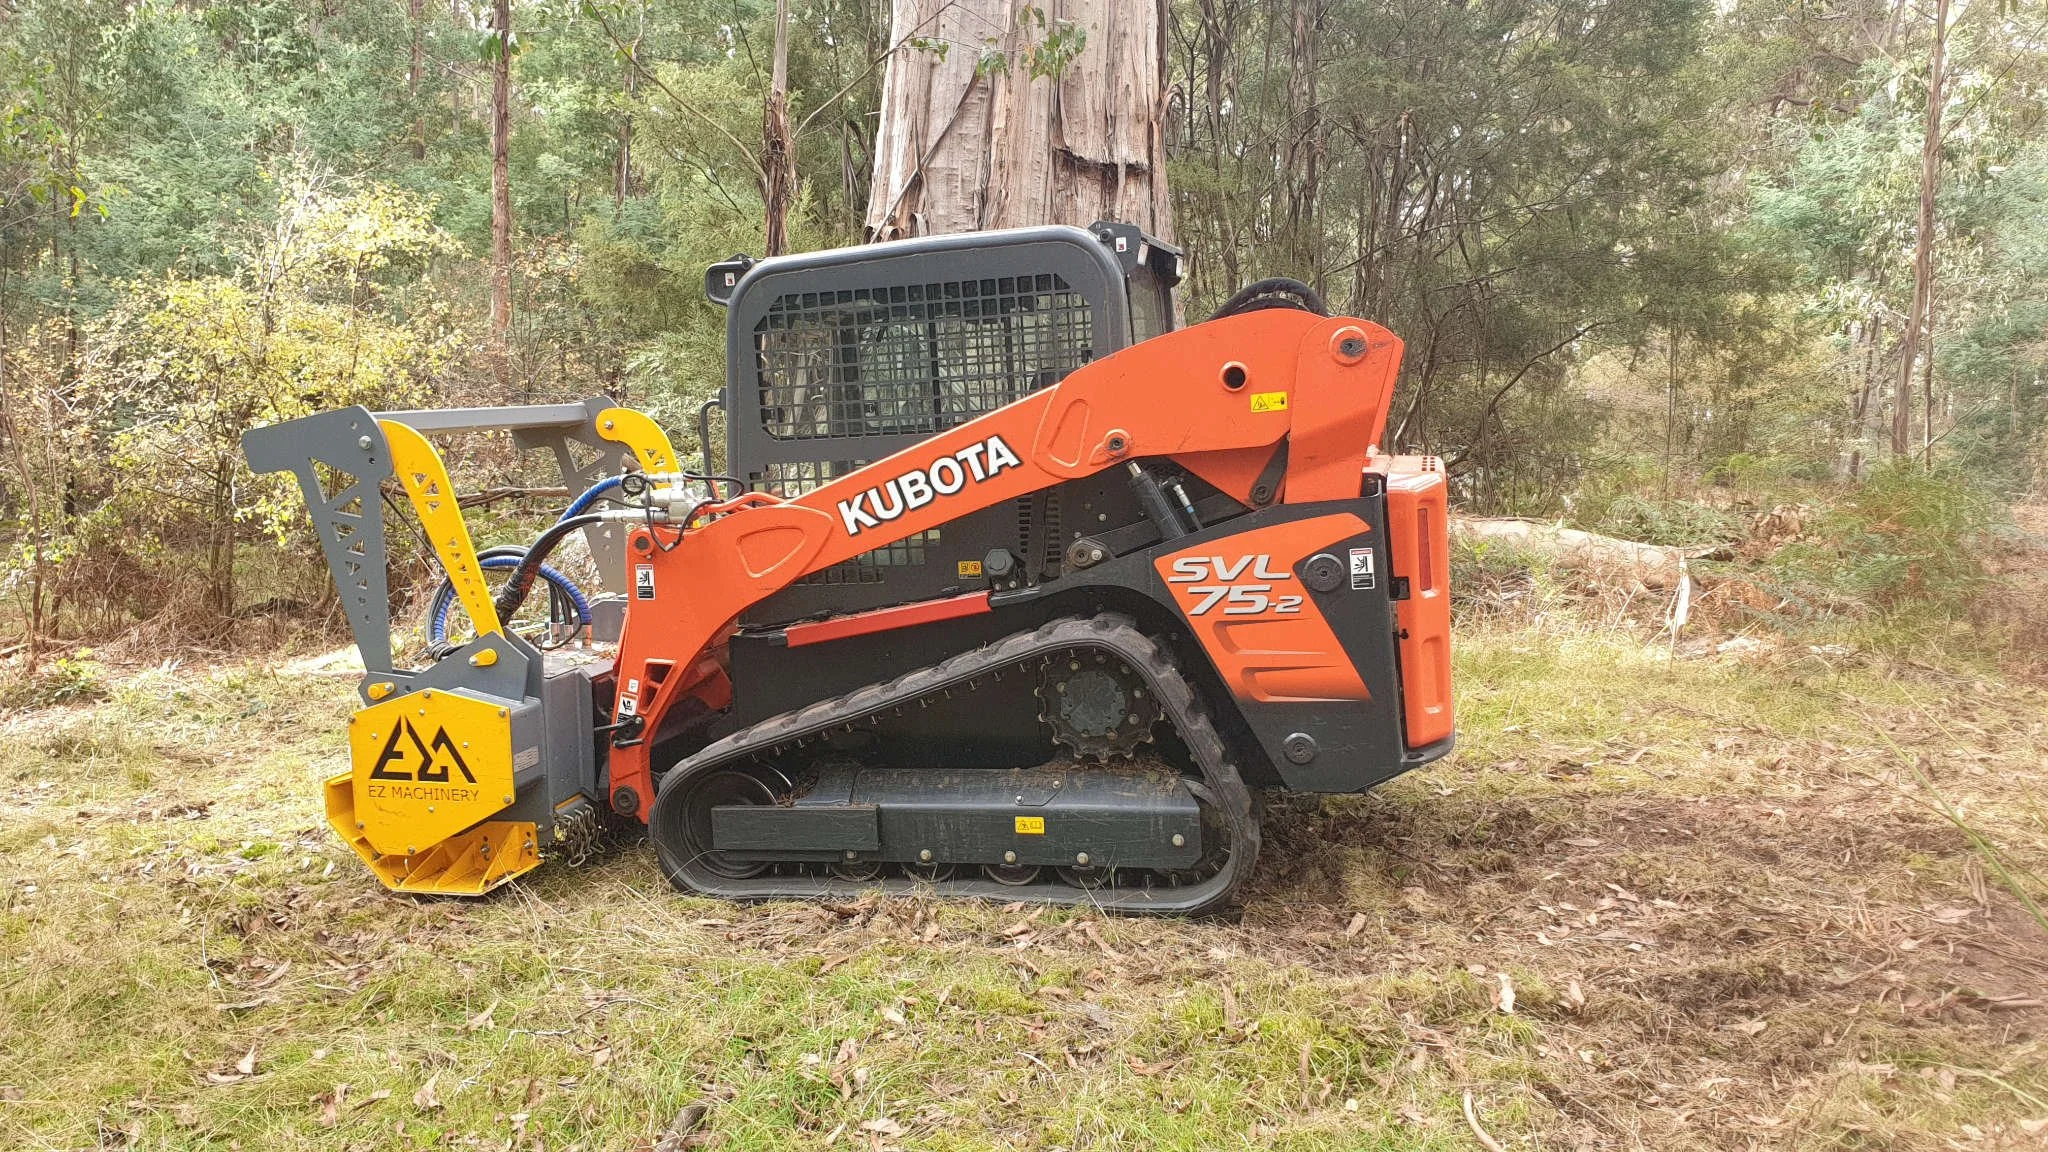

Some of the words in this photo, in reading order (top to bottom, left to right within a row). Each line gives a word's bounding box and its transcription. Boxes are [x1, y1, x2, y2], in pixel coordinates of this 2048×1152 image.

[837, 434, 1023, 536] KUBOTA
[1167, 554, 1291, 583] SVL
[1187, 584, 1303, 615] 75-2
[368, 785, 386, 798] EZ
[391, 786, 480, 802] MACHINERY
